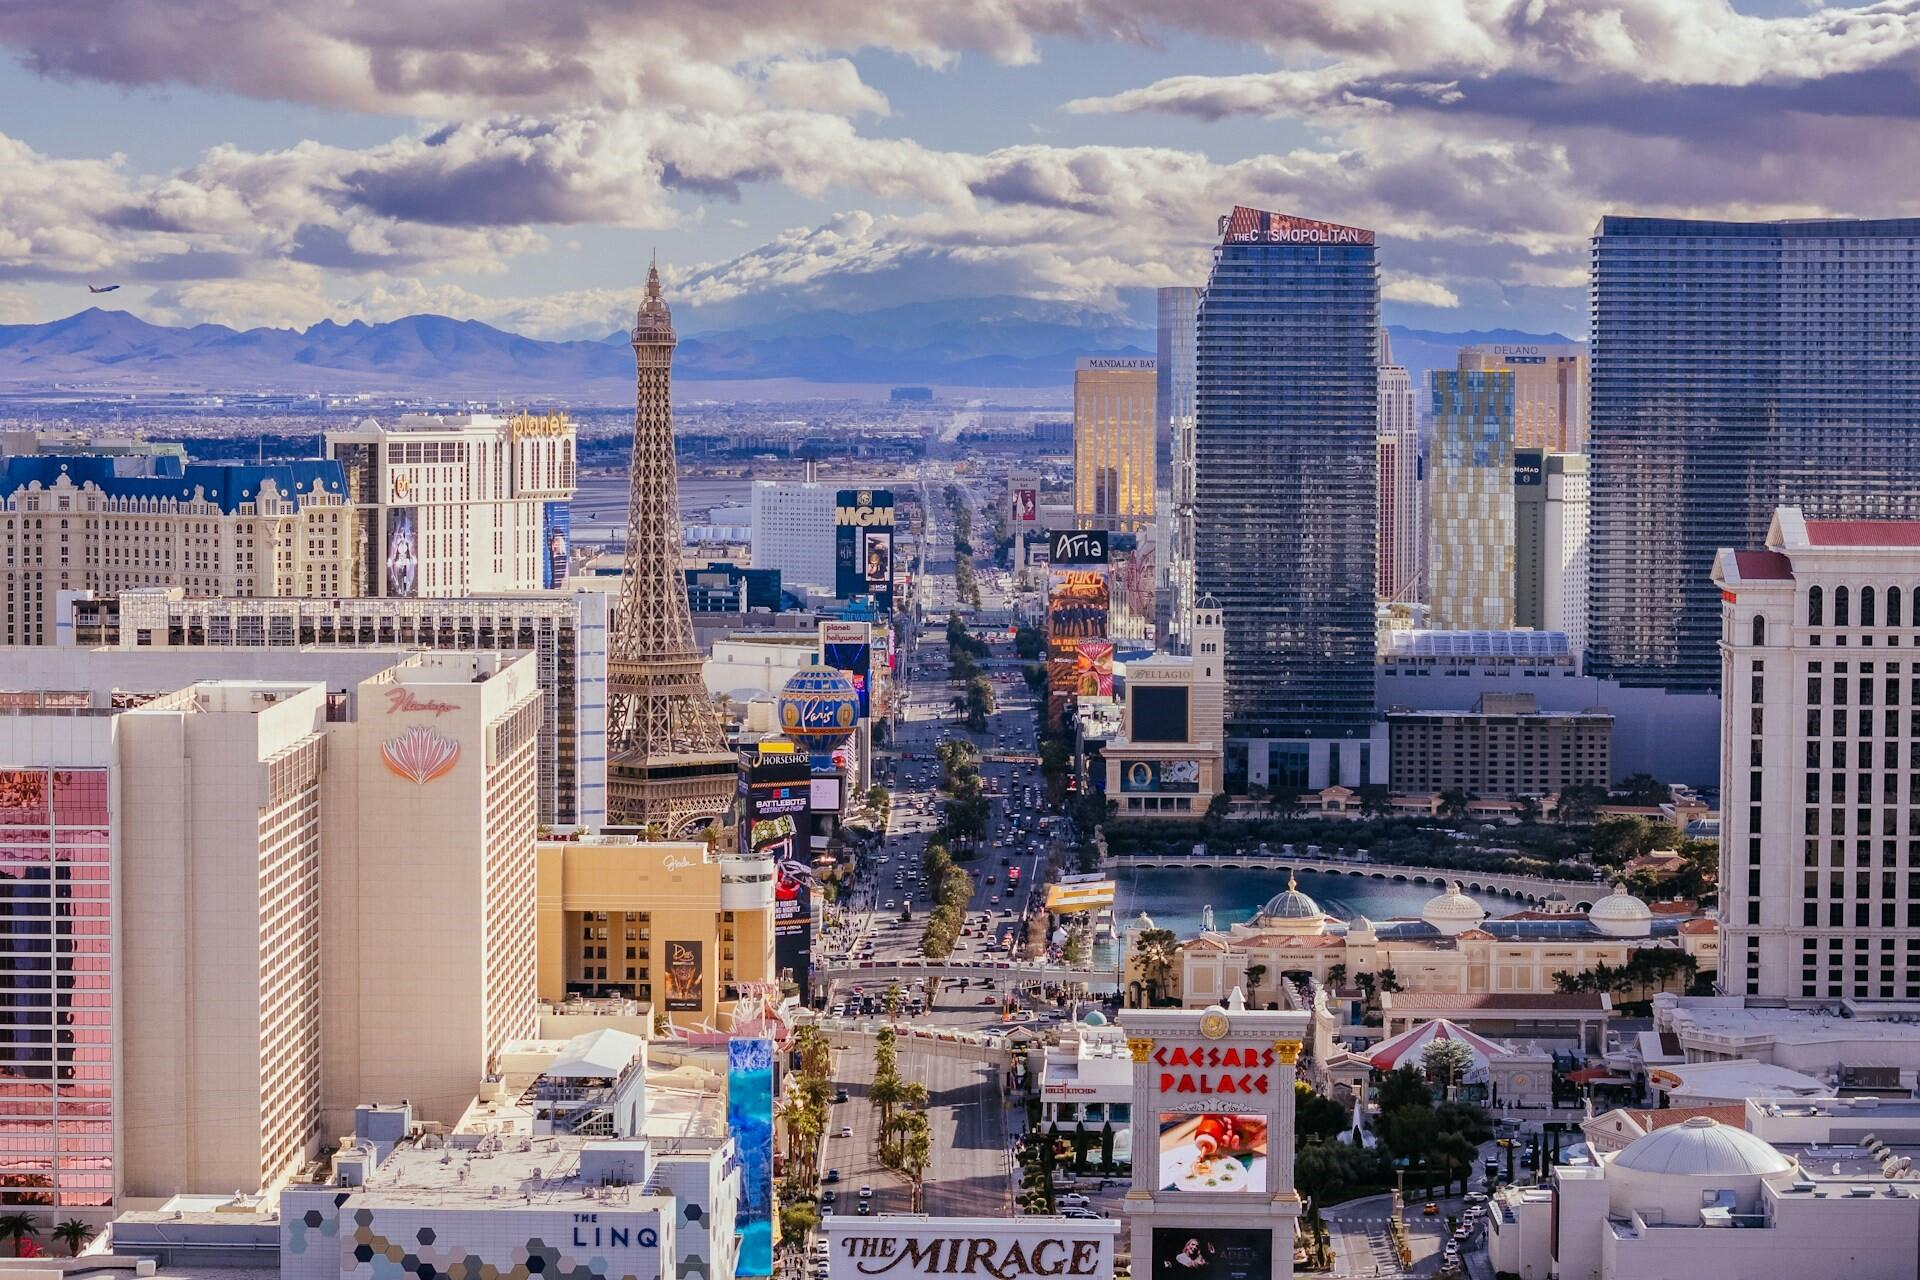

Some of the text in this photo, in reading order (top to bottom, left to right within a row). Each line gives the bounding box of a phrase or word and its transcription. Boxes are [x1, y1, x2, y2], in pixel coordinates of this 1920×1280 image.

[1234, 229, 1359, 242] THE CSMOPOLITAN
[1494, 346, 1538, 355] DELANO
[1089, 360, 1156, 368] MANDALAY BAY
[513, 409, 571, 444] planet
[834, 506, 896, 527] MGM
[1055, 534, 1102, 559] Aria
[826, 624, 851, 633] planet
[826, 634, 863, 642] hollywood
[1131, 669, 1191, 679] BELLAGIO
[802, 695, 834, 733] Paris
[763, 754, 809, 766] HORSESHOE
[756, 798, 807, 809] BATTLEBOTS
[1154, 1046, 1276, 1068] CAESARS
[1160, 1073, 1269, 1095] PALACE
[574, 1213, 598, 1223] THE
[573, 1226, 659, 1248] LINQ
[841, 1237, 1101, 1280] THE MIRAGE
